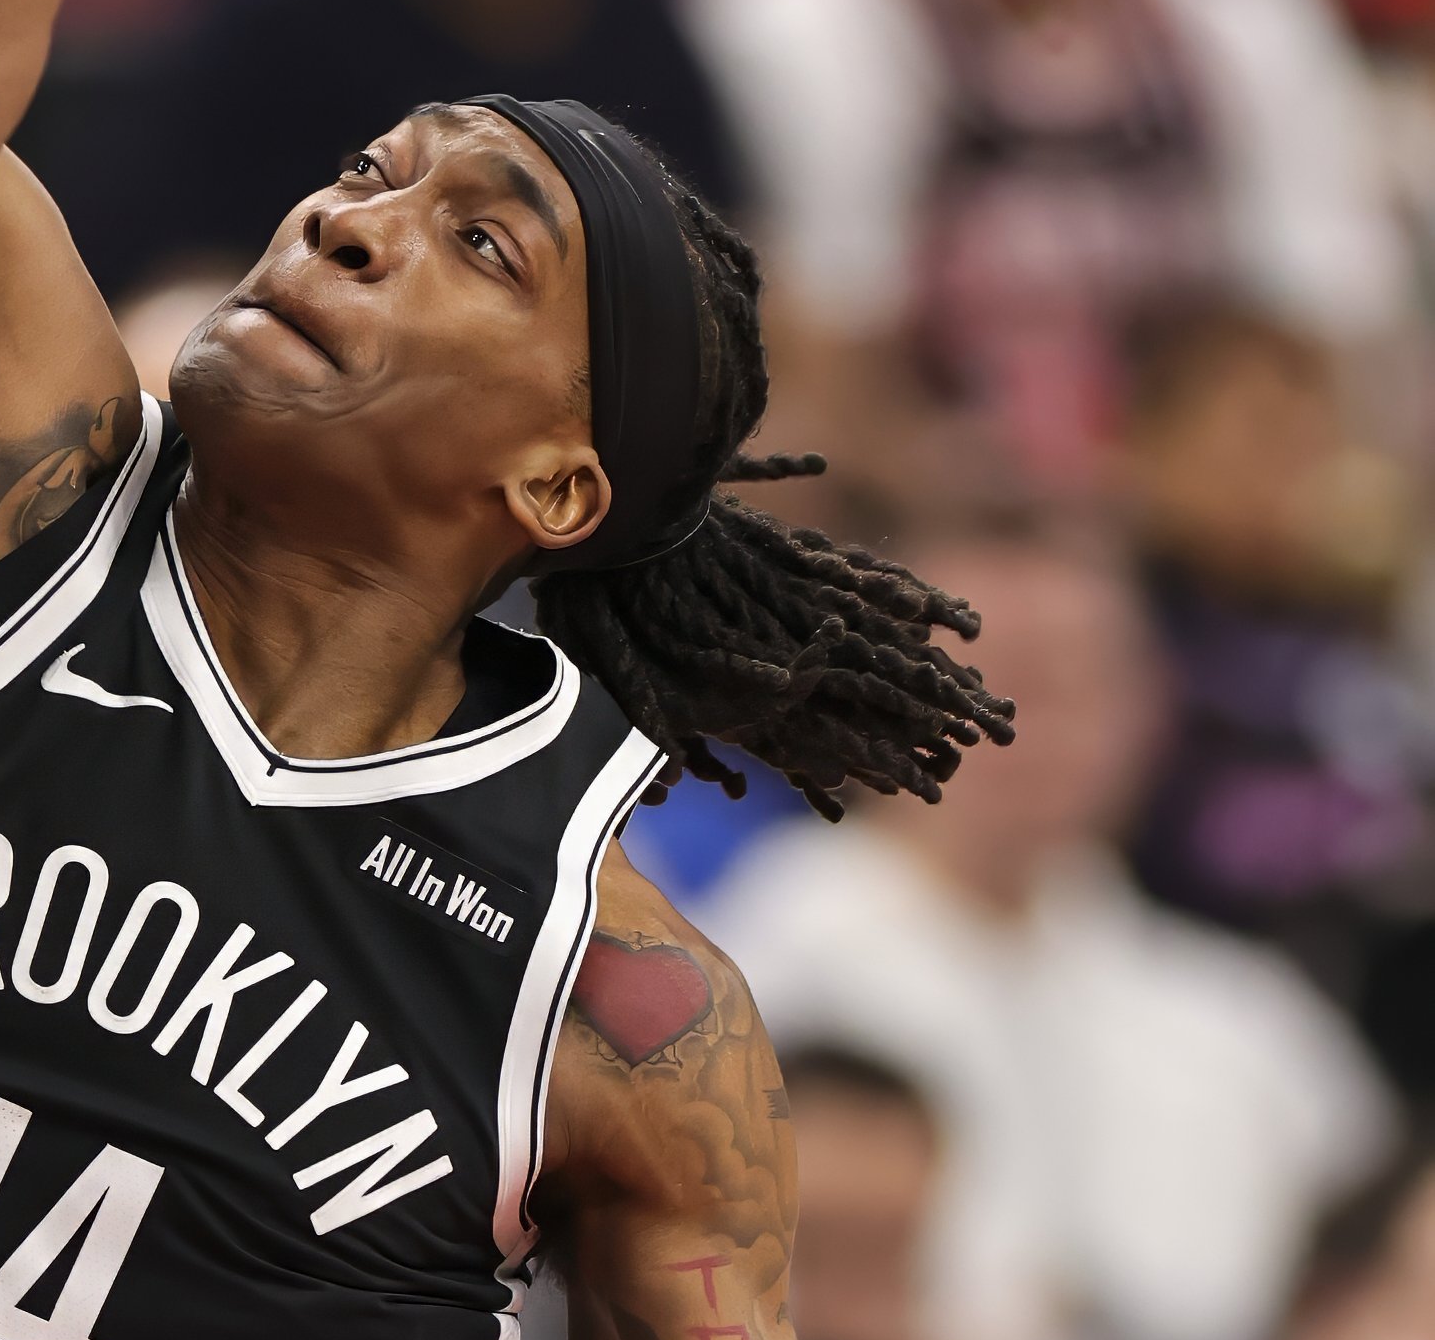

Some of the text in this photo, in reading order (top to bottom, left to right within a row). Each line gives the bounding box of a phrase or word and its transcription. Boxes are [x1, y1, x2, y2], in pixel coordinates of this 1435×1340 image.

[360, 834, 515, 943] All In Won
